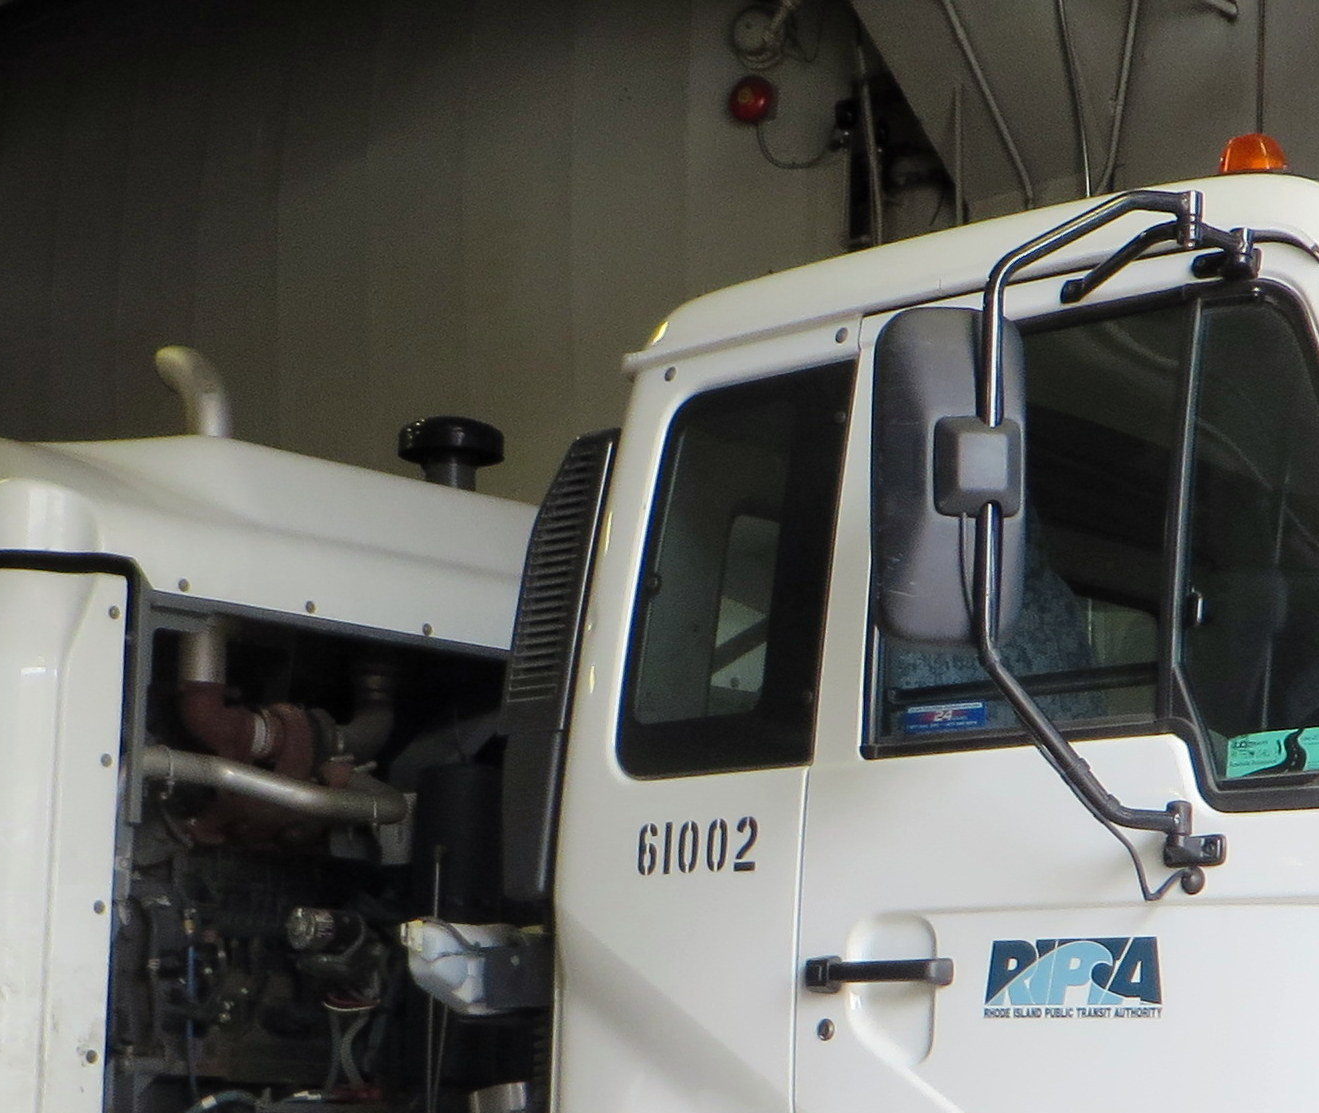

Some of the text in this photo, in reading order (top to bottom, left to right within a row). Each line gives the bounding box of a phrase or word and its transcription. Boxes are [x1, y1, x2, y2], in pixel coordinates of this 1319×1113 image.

[637, 815, 758, 876] 61002
[985, 936, 1162, 1005] RIPTA
[984, 1006, 1162, 1019] RHODE ISLAND PUBLIC TRANSIT AUTHORITY
